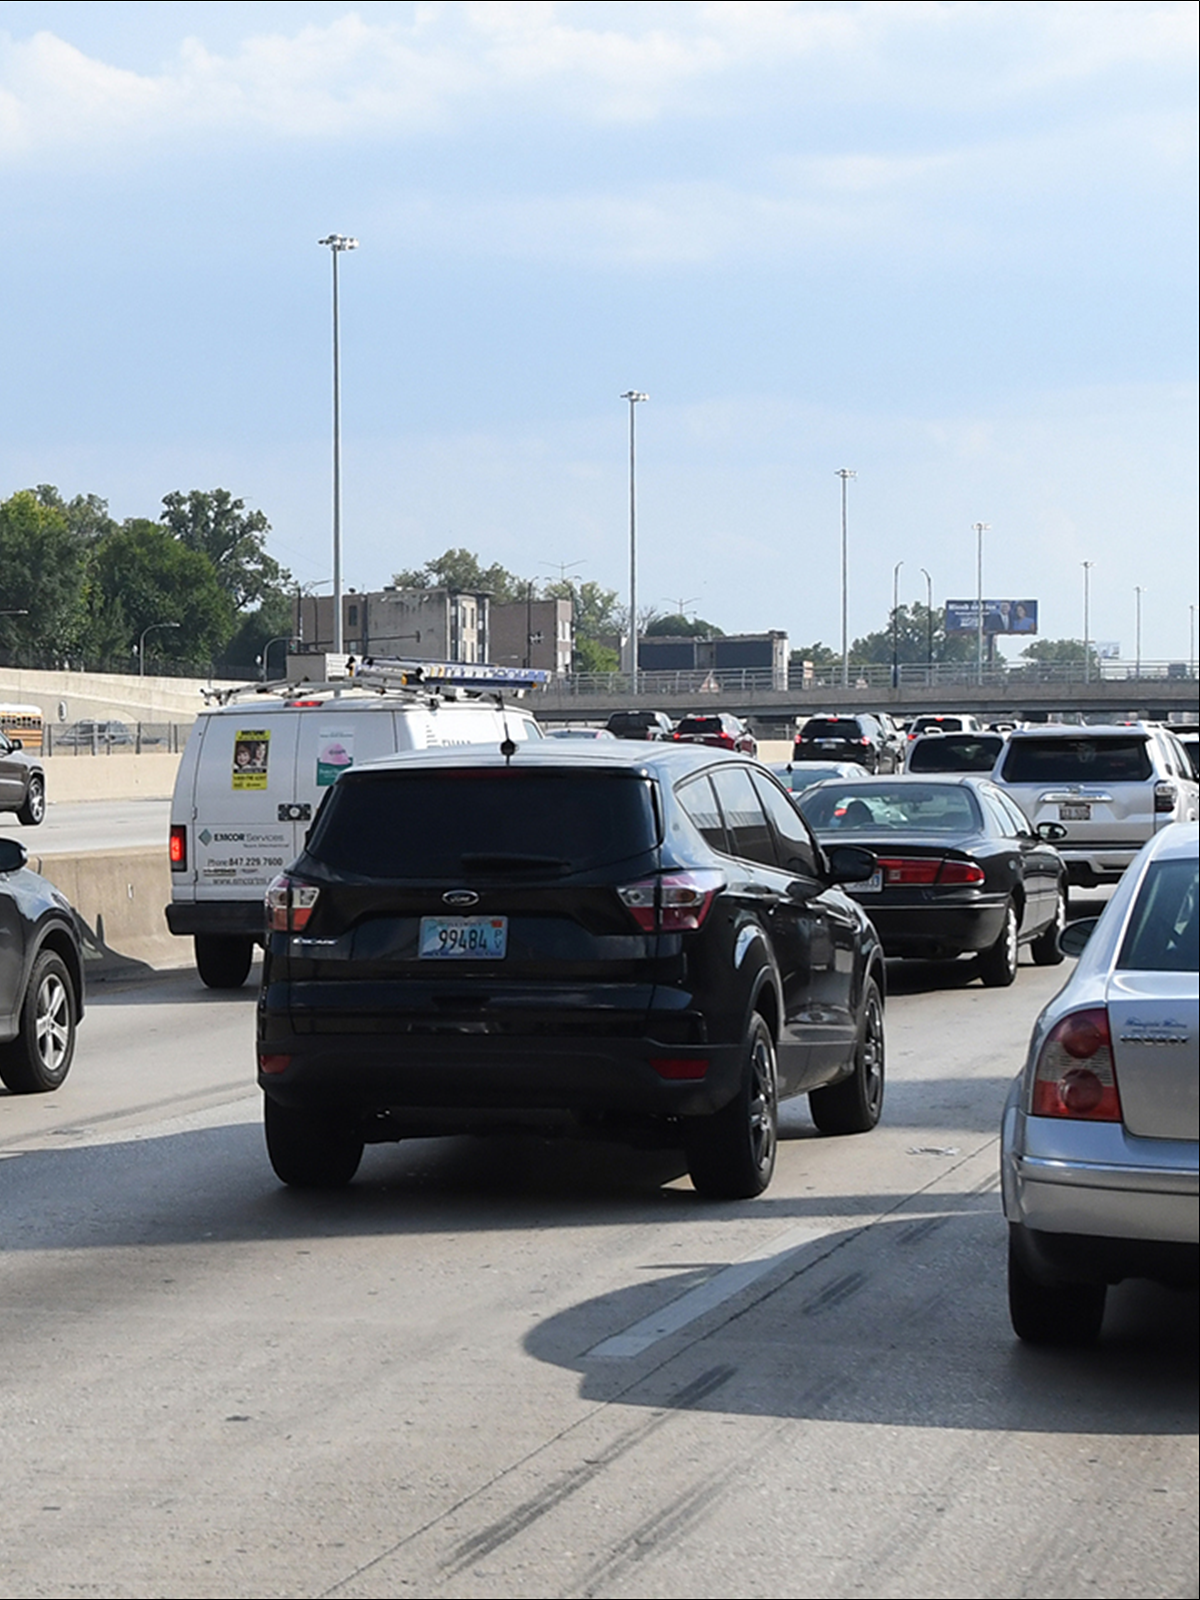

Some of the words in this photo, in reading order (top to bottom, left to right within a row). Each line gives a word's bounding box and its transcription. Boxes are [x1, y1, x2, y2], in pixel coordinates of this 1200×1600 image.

[214, 833, 245, 842] EMCOR
[246, 833, 285, 842] Services
[438, 929, 487, 951] 99484
